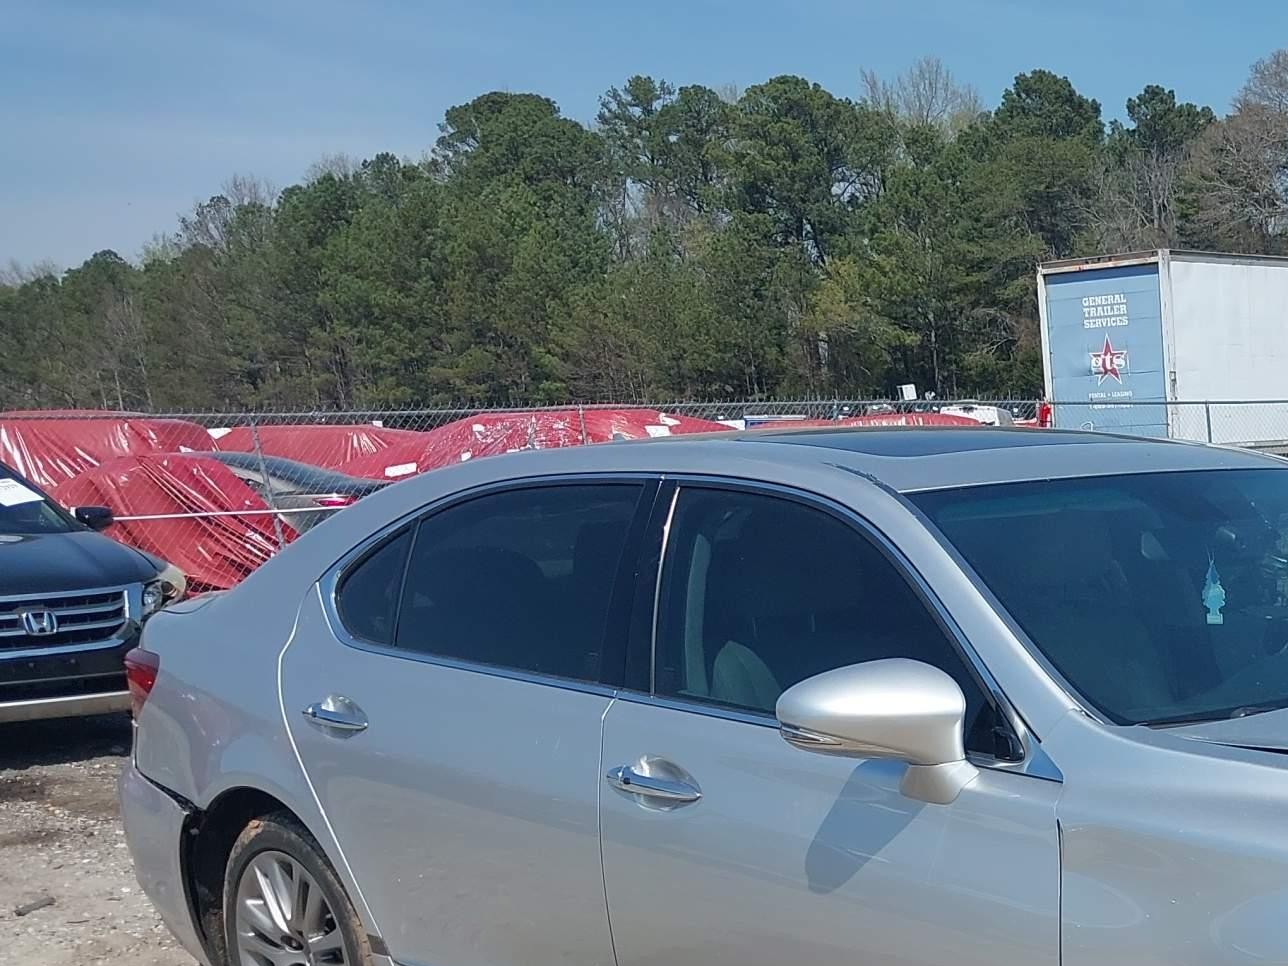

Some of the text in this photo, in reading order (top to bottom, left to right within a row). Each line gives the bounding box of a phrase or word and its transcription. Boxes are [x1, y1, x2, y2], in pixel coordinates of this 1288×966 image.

[1082, 294, 1127, 307] GENERAL
[1083, 304, 1127, 317] TRAILER
[1083, 316, 1128, 329] SERVICES
[1091, 352, 1126, 374] gts
